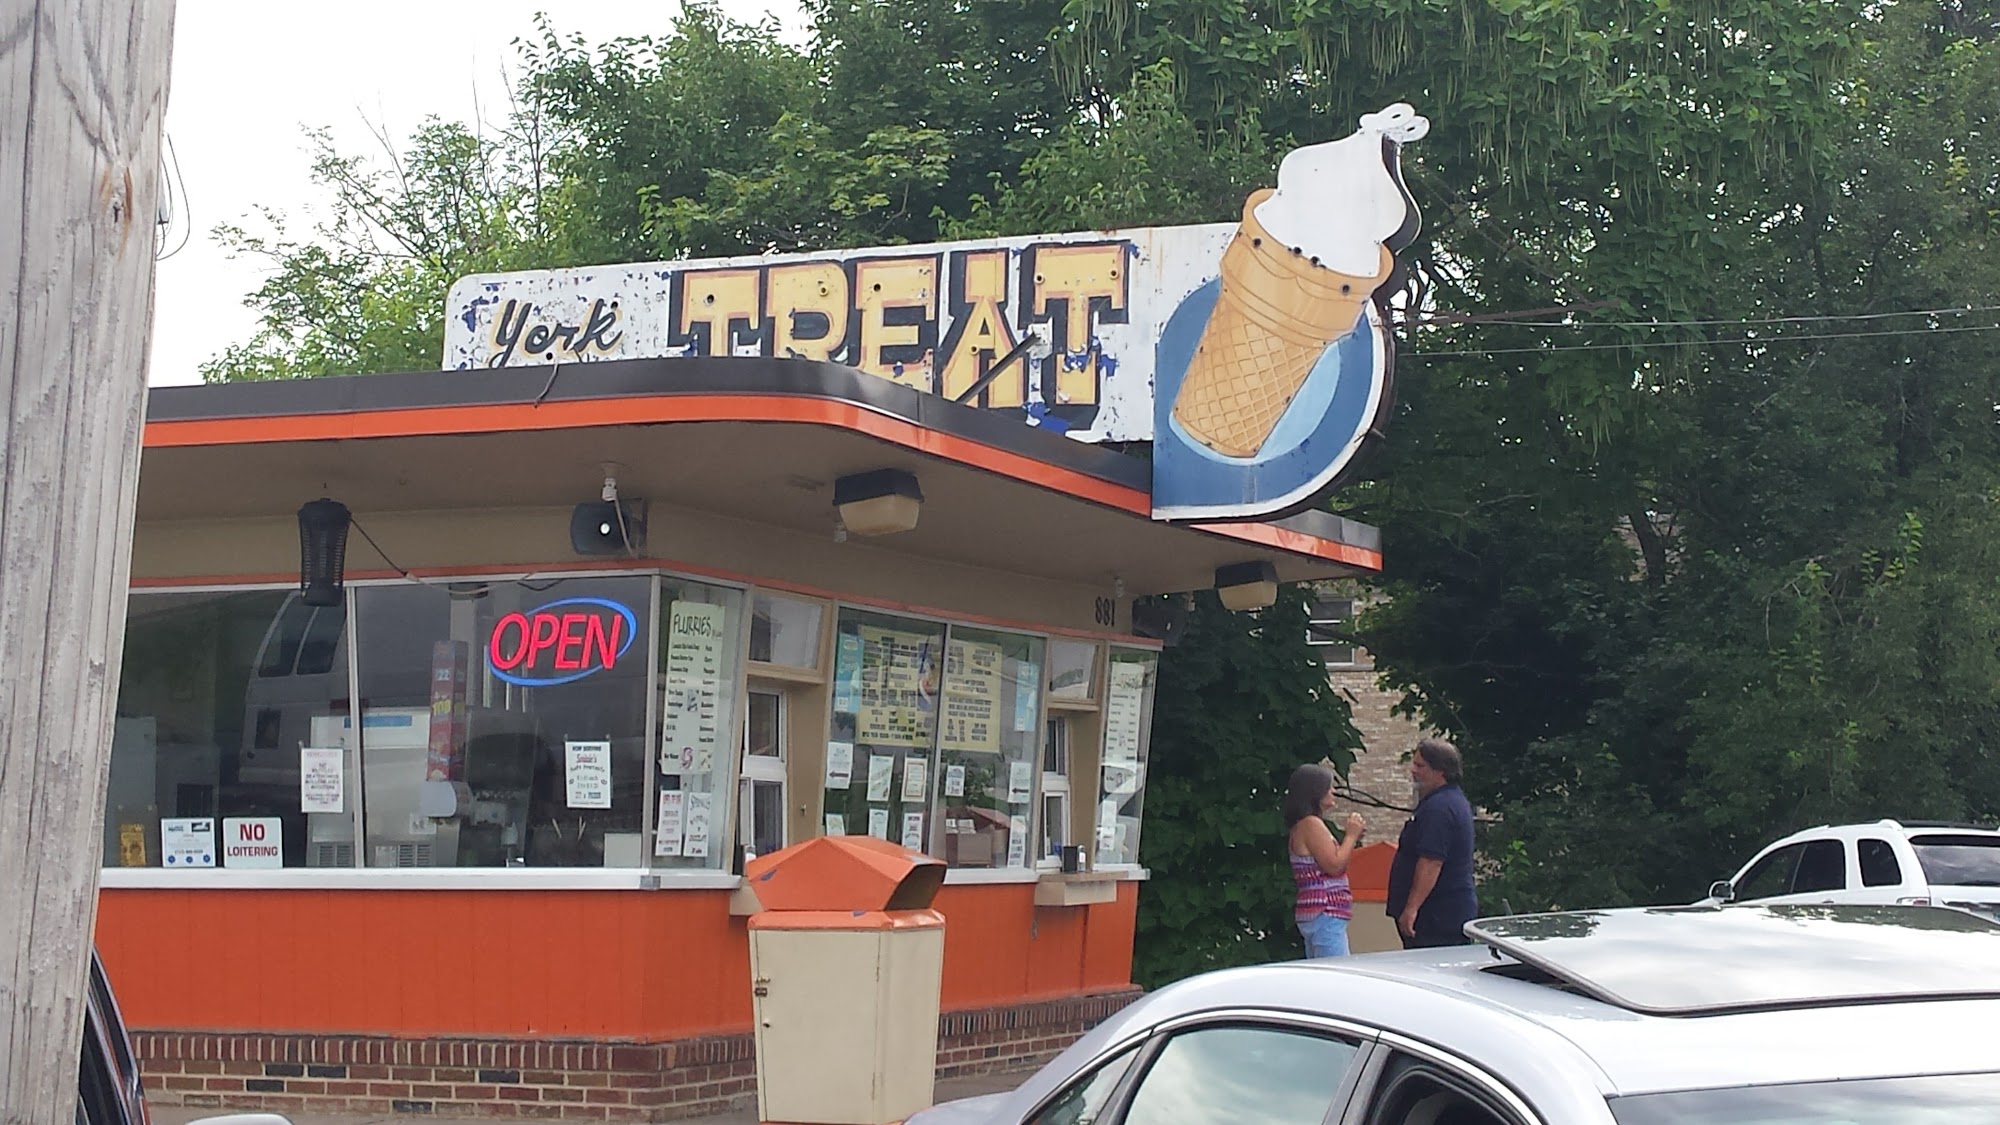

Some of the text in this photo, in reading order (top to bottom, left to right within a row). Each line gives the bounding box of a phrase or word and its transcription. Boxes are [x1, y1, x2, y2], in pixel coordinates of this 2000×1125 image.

[490, 240, 1128, 430] York TREAT
[673, 613, 712, 637] FLURRIES
[1095, 596, 1115, 627] 881
[489, 611, 622, 670] OPEN
[240, 823, 265, 841] NO
[227, 846, 278, 857] LOITERING
